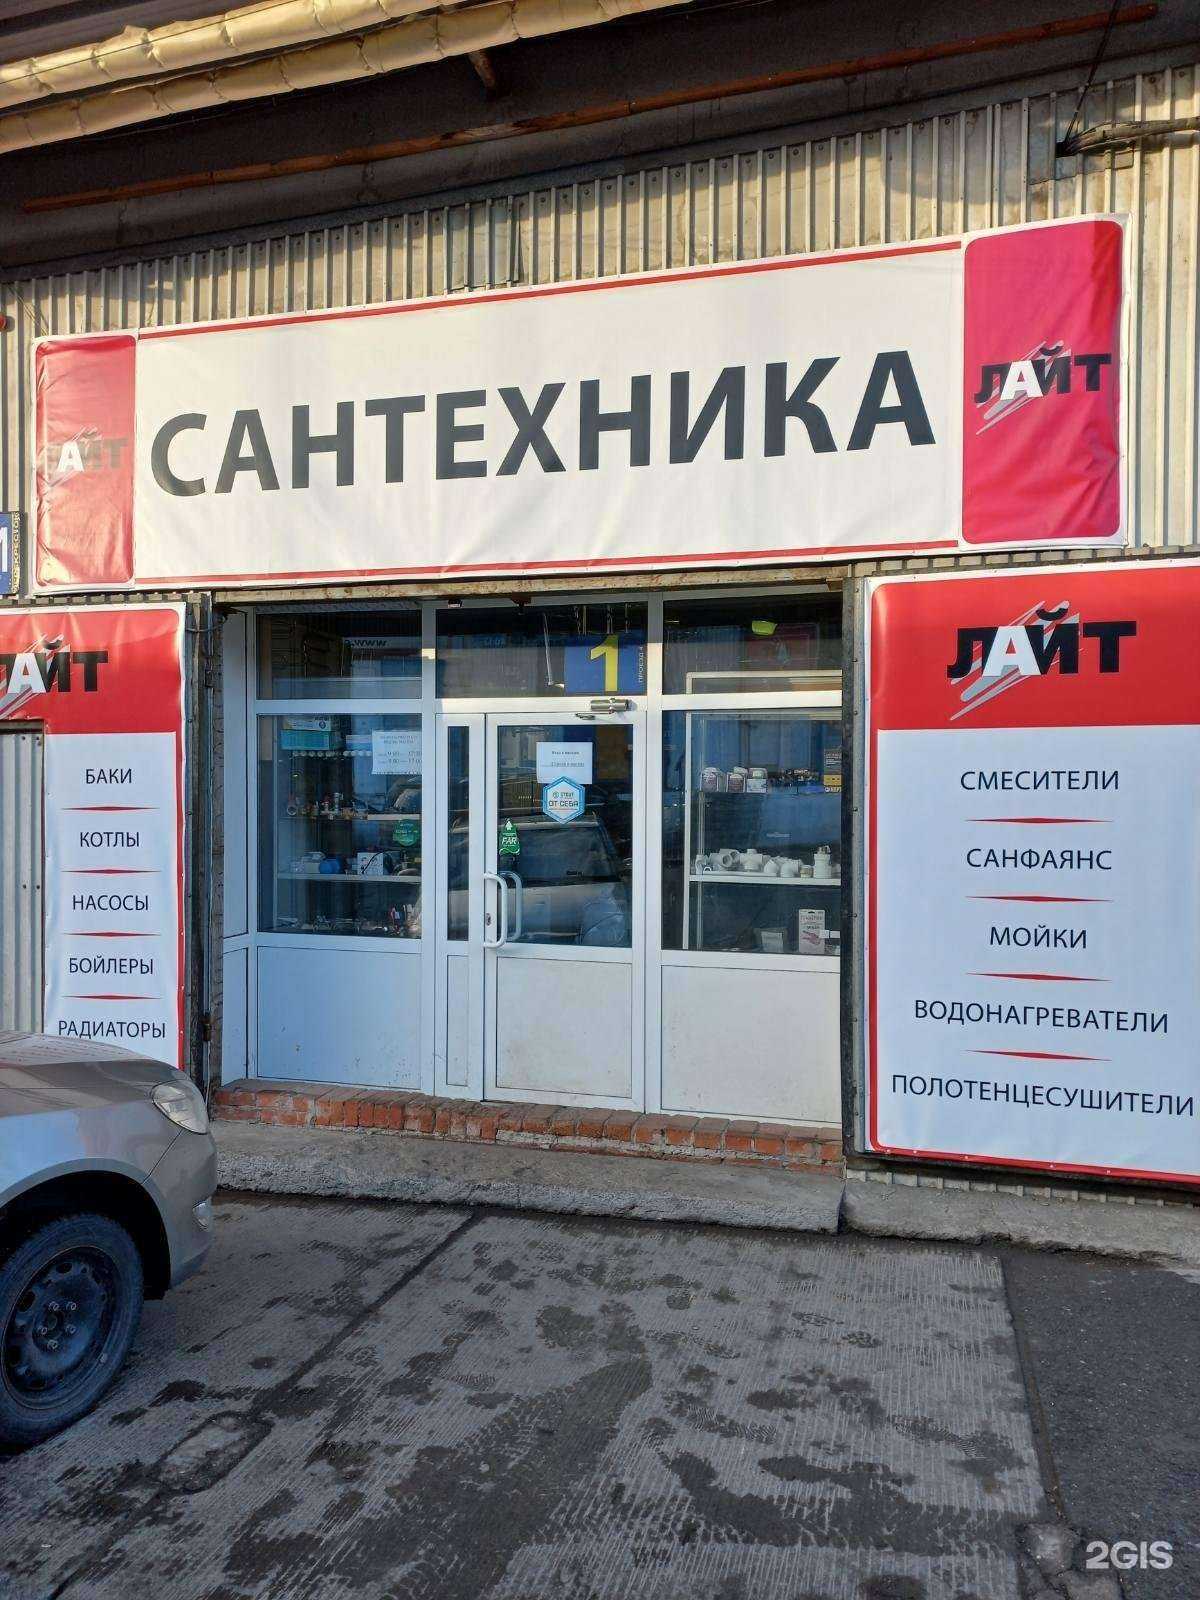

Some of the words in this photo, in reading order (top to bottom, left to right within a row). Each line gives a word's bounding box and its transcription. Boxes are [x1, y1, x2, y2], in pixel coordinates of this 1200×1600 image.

[974, 344, 1112, 404] ЛАЙТ
[151, 350, 936, 497] САНТЕХНИКА
[946, 606, 1137, 679] ЛАЙТ
[590, 635, 619, 692] 1
[85, 768, 132, 785] БАКИ
[960, 770, 1120, 791] СМЕСИТЕЛИ
[80, 831, 140, 848] КОТЛЫ
[966, 848, 1112, 870] САНФАЯНС
[72, 894, 149, 911] НАСОСЫ
[989, 924, 1087, 949] МОЙКИ
[69, 955, 154, 975] БОЙЛЕРЫ
[915, 1000, 1168, 1034] ВОДОНАГРЕВАТЕЛИ
[58, 1020, 166, 1039] РАДИАТОРЫ
[892, 1075, 1194, 1117] ПОЛОТЕНЦЕСУШИТЕЛИ
